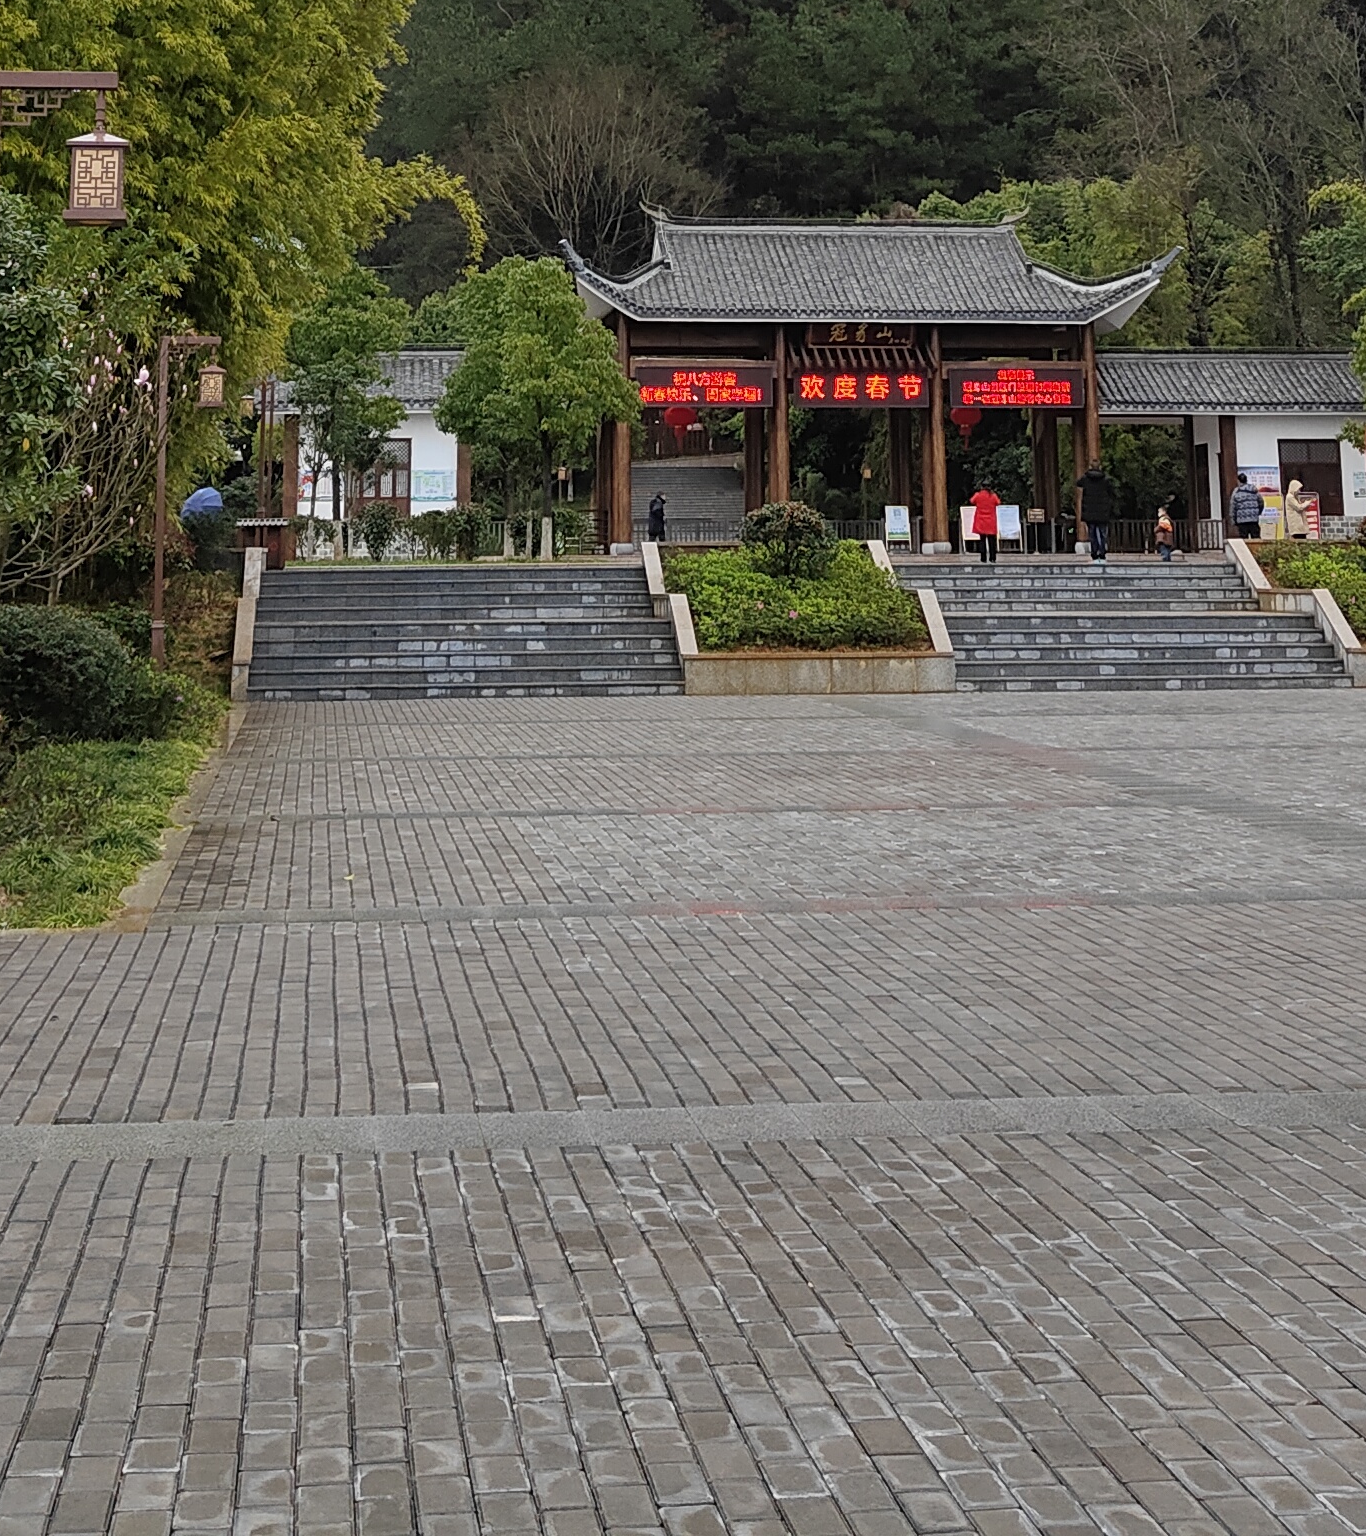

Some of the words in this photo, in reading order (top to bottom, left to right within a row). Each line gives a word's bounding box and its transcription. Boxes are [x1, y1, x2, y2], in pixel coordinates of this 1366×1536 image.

[672, 371, 737, 386] 祝八方游客
[800, 374, 922, 400] 欢度春节
